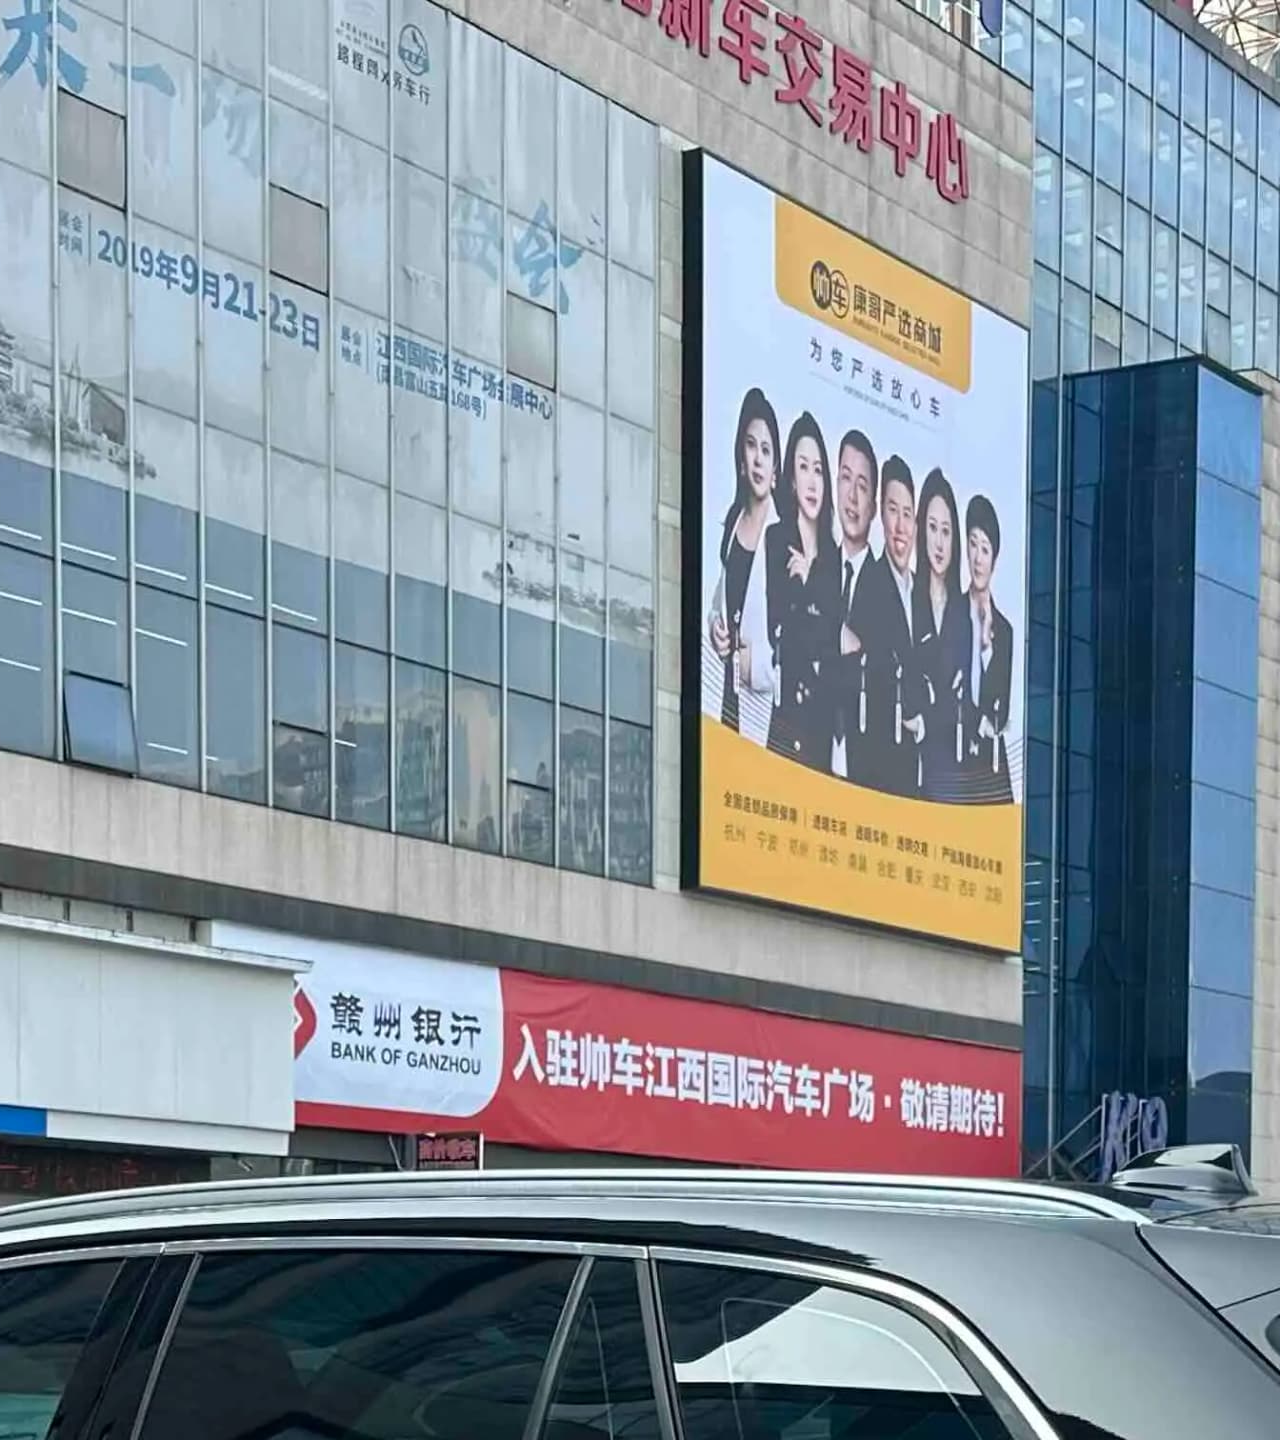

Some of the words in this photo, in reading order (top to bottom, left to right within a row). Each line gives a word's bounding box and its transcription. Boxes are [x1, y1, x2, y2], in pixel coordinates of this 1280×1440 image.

[622, 0, 970, 205] 新车交易中心
[330, 992, 482, 1050] 赣州银行
[330, 1041, 377, 1064] BANK
[380, 1047, 402, 1066] OF
[406, 1051, 482, 1076] GANZHOU
